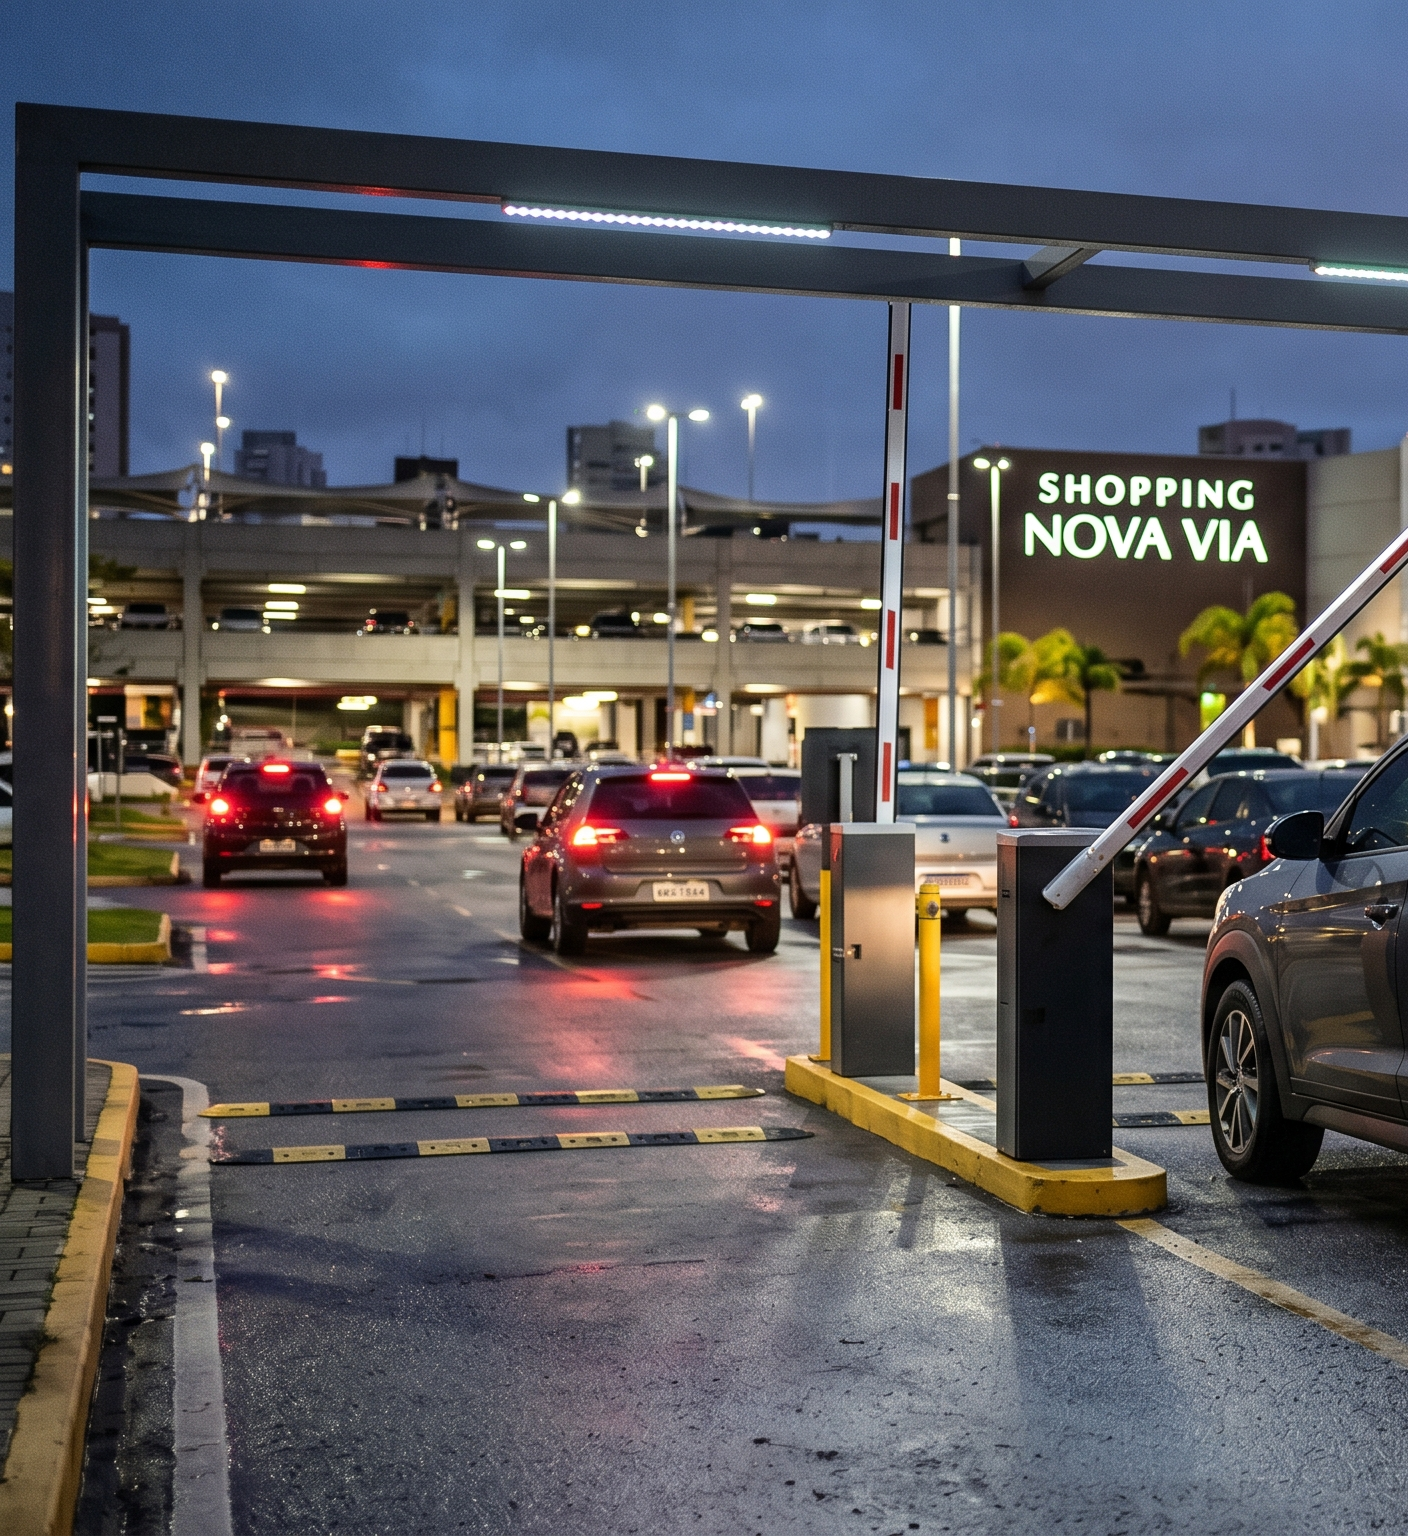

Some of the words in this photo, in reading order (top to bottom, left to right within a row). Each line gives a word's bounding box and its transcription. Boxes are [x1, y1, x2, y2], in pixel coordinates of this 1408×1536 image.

[1038, 472, 1255, 511] SHOPPING
[1024, 512, 1173, 560] NOVA
[1181, 517, 1269, 563] VIA
